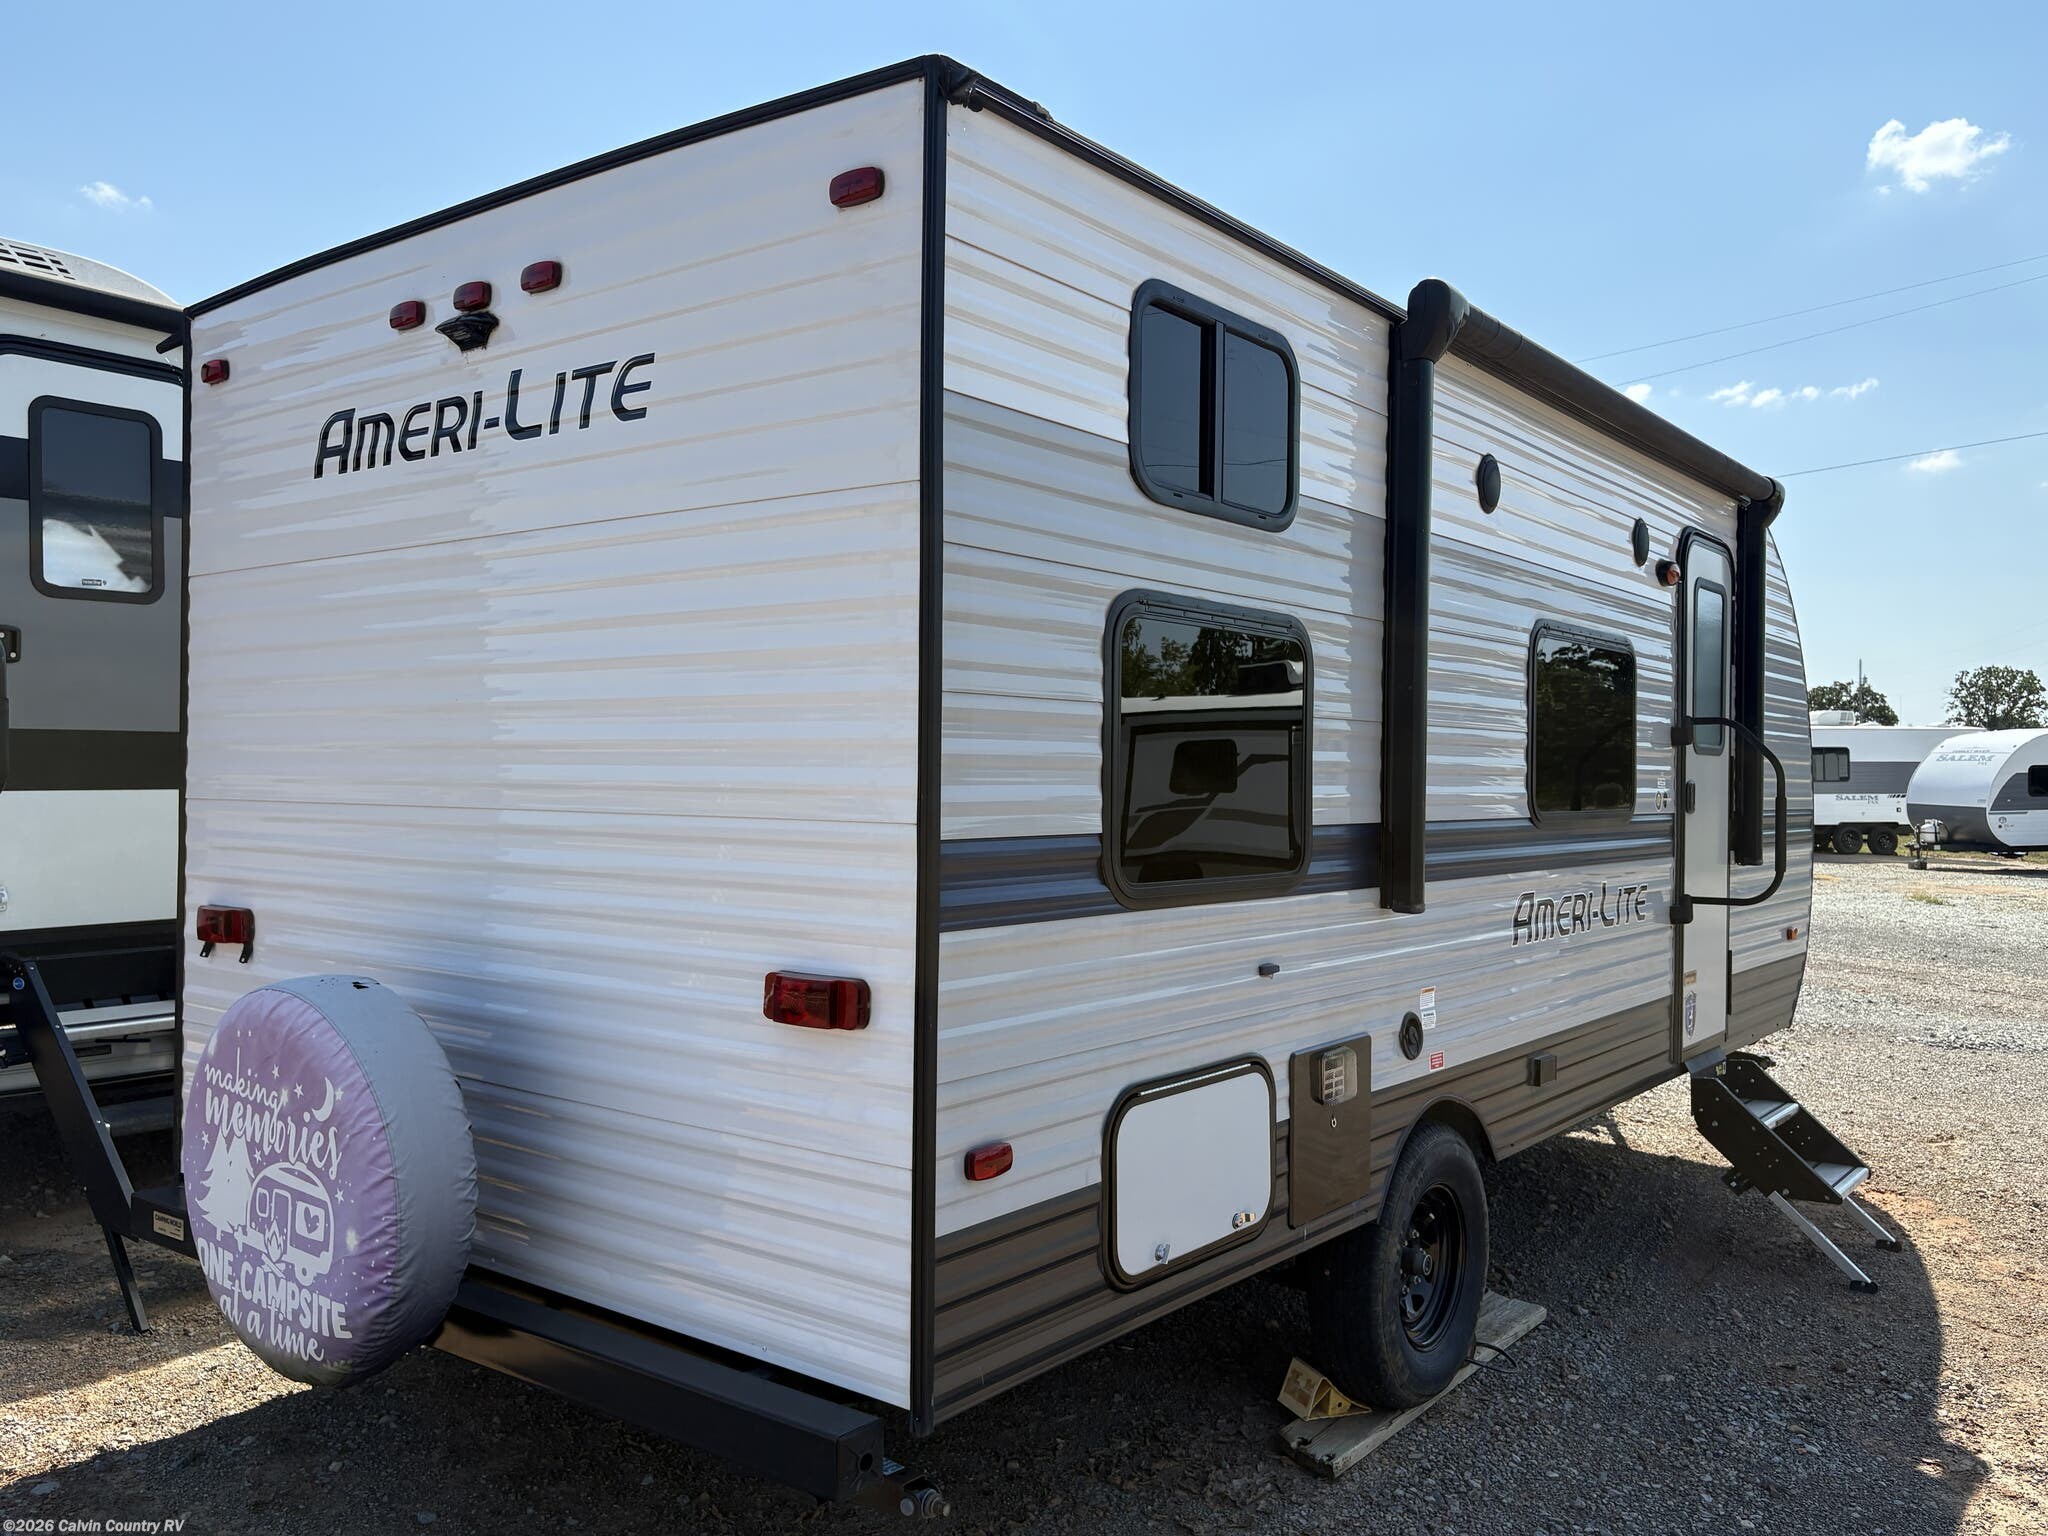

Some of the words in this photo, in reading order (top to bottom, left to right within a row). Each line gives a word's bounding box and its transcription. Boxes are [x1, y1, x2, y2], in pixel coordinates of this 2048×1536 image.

[314, 352, 655, 479] AMERI-LITE
[1835, 793, 1879, 801] SALEM
[1936, 753, 1996, 762] SALEM
[1512, 881, 1648, 947] AMERI-LITE
[205, 1047, 283, 1144] making
[206, 1087, 342, 1180] memories
[197, 1237, 234, 1290] ONE
[240, 1261, 353, 1339] CAMPSITE
[220, 1280, 243, 1325] at
[247, 1311, 265, 1339] a
[268, 1302, 325, 1361] time
